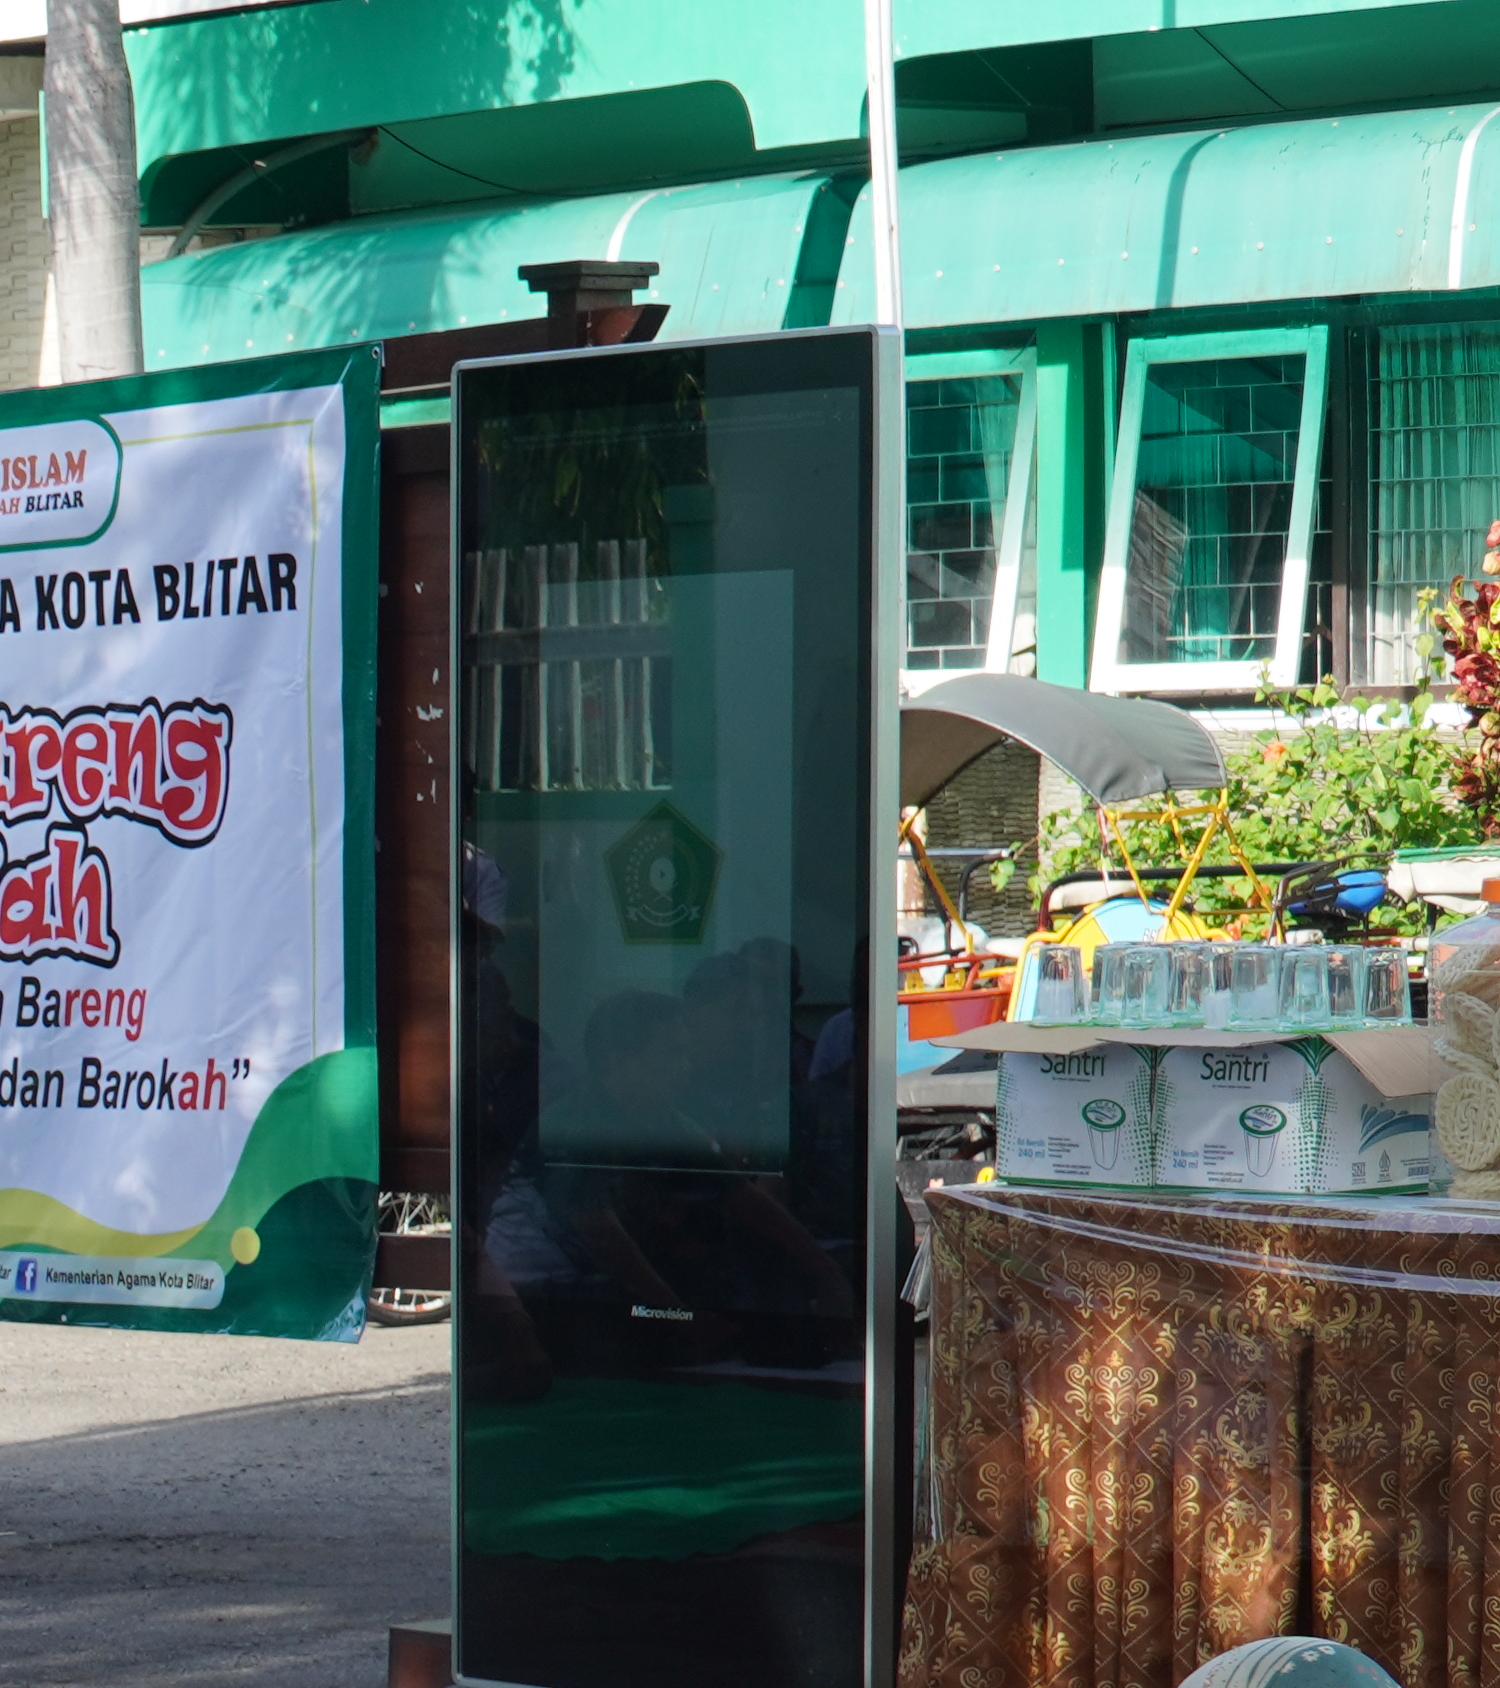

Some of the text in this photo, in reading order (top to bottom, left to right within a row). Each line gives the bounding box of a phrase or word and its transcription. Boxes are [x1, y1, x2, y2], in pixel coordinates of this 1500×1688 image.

[1, 449, 87, 493] ISLAM
[24, 490, 84, 514] BLITAR
[35, 568, 142, 631] KOTA
[153, 552, 298, 622] BLITAR
[16, 975, 148, 1042] Bareng
[1200, 1052, 1269, 1083] Santri
[45, 1266, 215, 1291] Kementerian Agama Kota Blitar
[631, 1304, 694, 1321] Microvision
